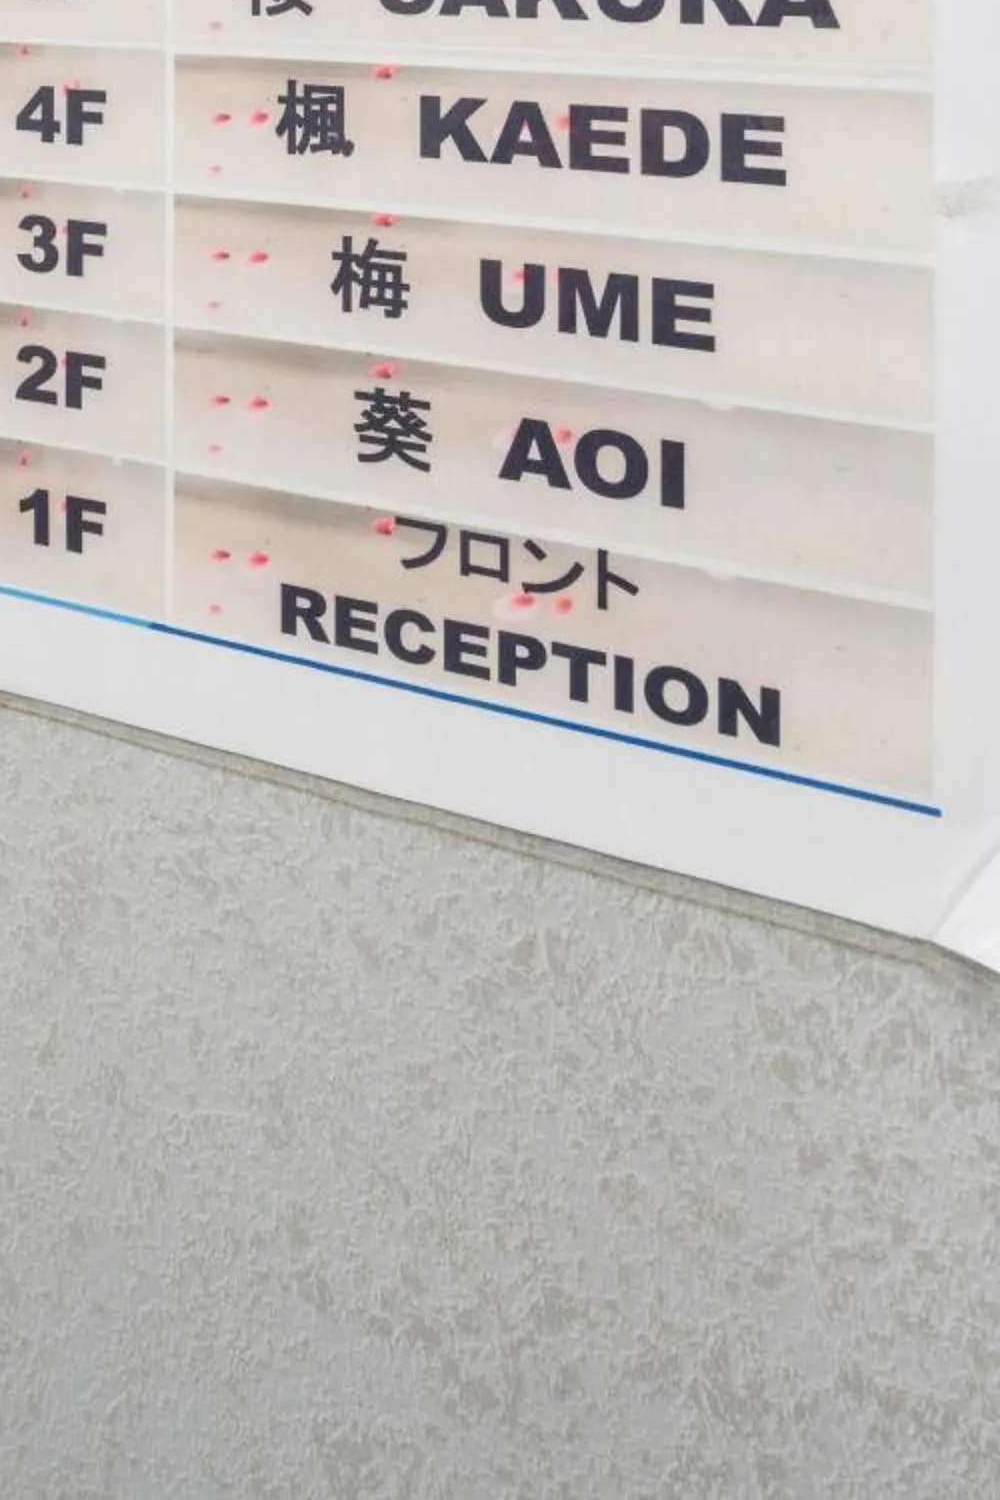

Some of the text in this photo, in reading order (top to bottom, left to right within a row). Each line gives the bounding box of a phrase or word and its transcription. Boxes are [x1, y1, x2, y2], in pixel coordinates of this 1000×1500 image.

[15, 78, 787, 187] 4F 楓 KAEDE
[16, 214, 716, 353] 3F 梅 UME
[15, 344, 685, 510] 2F 葵 AOI
[18, 488, 640, 611] 1F フロント
[278, 582, 781, 746] RECEPTION
